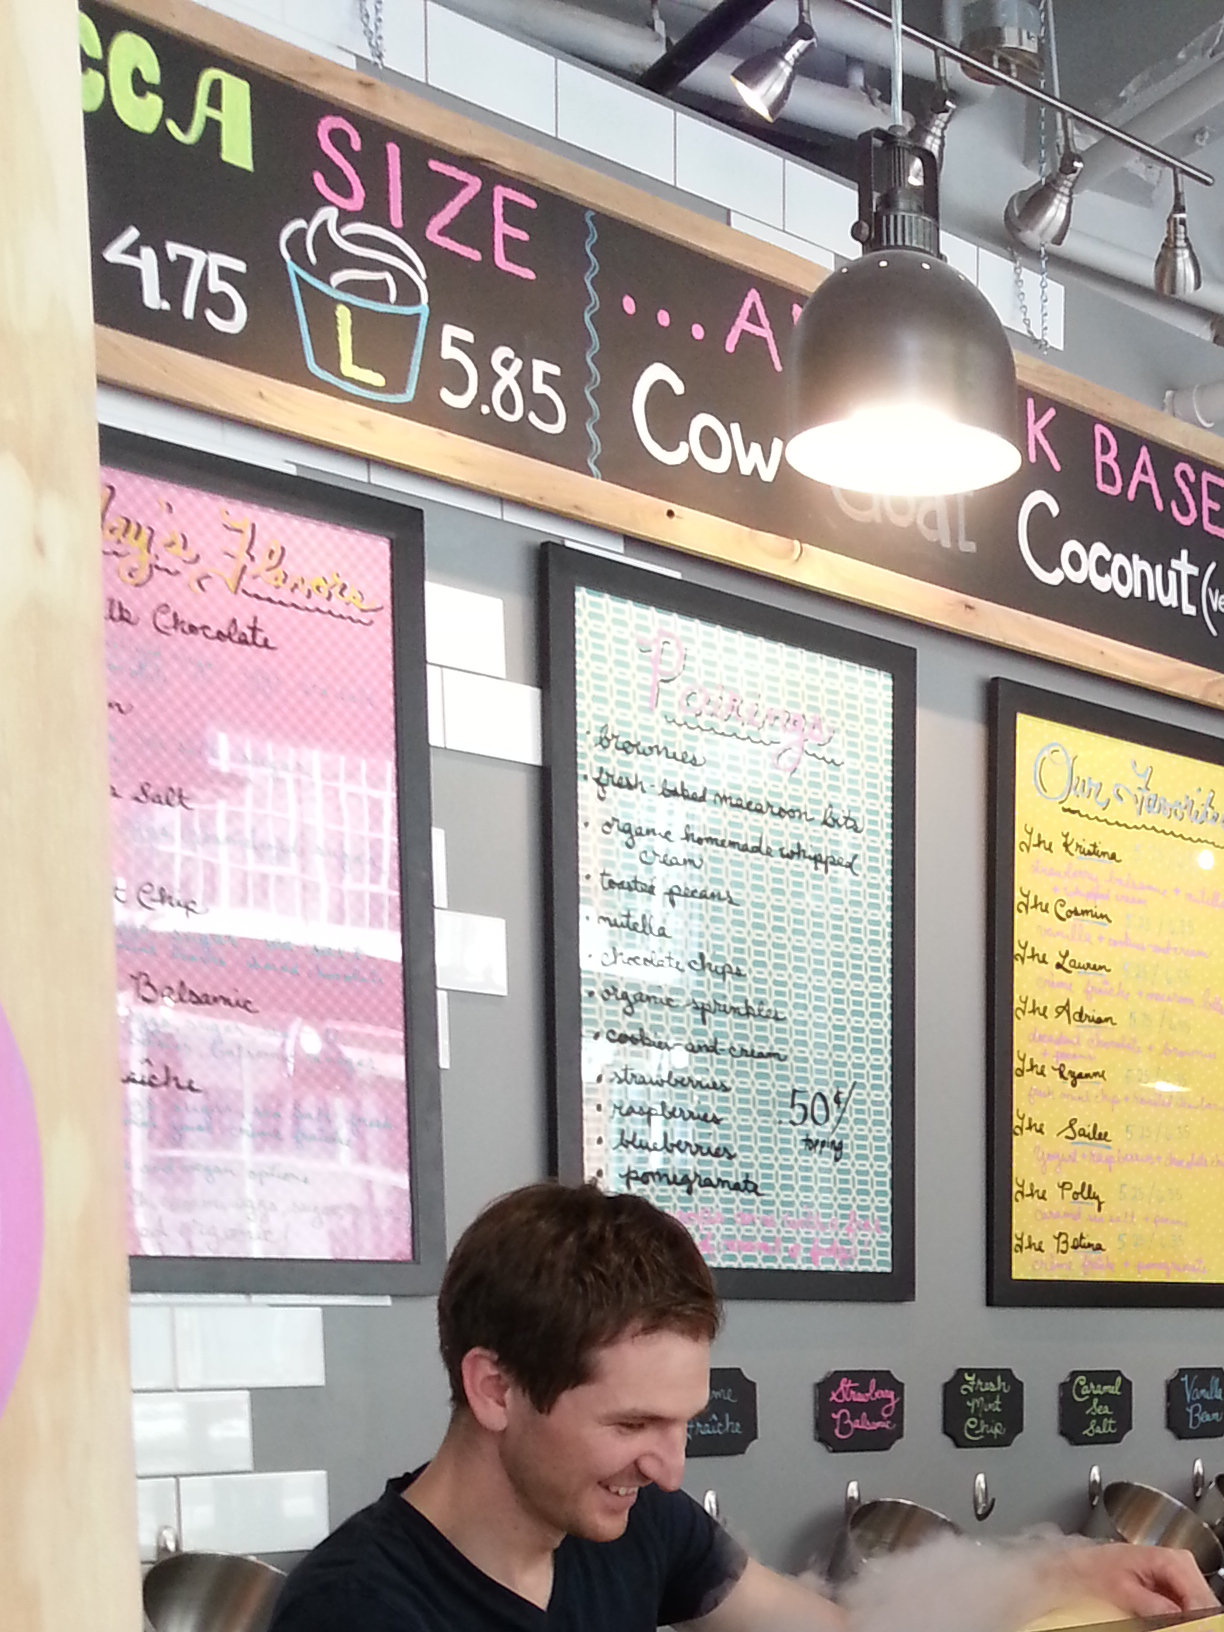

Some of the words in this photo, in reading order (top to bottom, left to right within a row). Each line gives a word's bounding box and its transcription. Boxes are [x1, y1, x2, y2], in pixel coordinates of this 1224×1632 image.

[312, 114, 538, 280] SIZE
[102, 225, 249, 334] 4.75
[335, 303, 387, 388] L
[440, 324, 567, 434] 5.85
[631, 362, 784, 483] Cow
[1017, 489, 1200, 616] Coconut
[153, 603, 278, 650] Chocolate
[636, 628, 836, 778] Pairings
[594, 723, 707, 767] brownies
[1033, 742, 1110, 811] Our
[131, 781, 196, 811] Salt
[713, 790, 815, 822] macaroon
[821, 804, 865, 834] bits
[601, 815, 674, 849] organic
[681, 825, 773, 857] homemade
[778, 841, 859, 877] whipped
[639, 849, 705, 870] cream
[1018, 823, 1054, 854] The
[1060, 831, 1123, 864] Kristina
[136, 881, 208, 918] Chip
[663, 884, 741, 909] pecans
[1016, 886, 1050, 915] The
[1054, 898, 1113, 924] Cosmin
[598, 909, 673, 939] nutella
[601, 946, 686, 972] chocolate
[687, 951, 747, 982] chips
[1013, 939, 1049, 965] The
[1054, 949, 1112, 974] Lauren
[130, 970, 260, 1014] Balsamic
[600, 989, 678, 1016] organic
[684, 995, 787, 1026] sprinkles
[1015, 995, 1048, 1021] The
[1054, 997, 1118, 1026] Adrian
[609, 1064, 732, 1093] strawberries
[1015, 1049, 1047, 1078] The
[611, 1100, 725, 1128] raspberries
[1012, 1108, 1045, 1136] The
[612, 1128, 738, 1160] blueberries
[618, 1166, 765, 1196] pomegranate
[1014, 1177, 1048, 1203] The
[1057, 1181, 1106, 1213] Polly
[1014, 1232, 1046, 1254] The
[1053, 1231, 1107, 1255] Betina
[960, 1372, 1011, 1395] Fresh
[1072, 1375, 1122, 1402] Caramel
[1180, 1373, 1224, 1403] Vanilla
[966, 1394, 1003, 1418] Mint
[1085, 1397, 1114, 1416] Sea
[1185, 1402, 1224, 1430] Bean
[964, 1417, 1007, 1441] Chip
[1082, 1416, 1118, 1437] Salt
